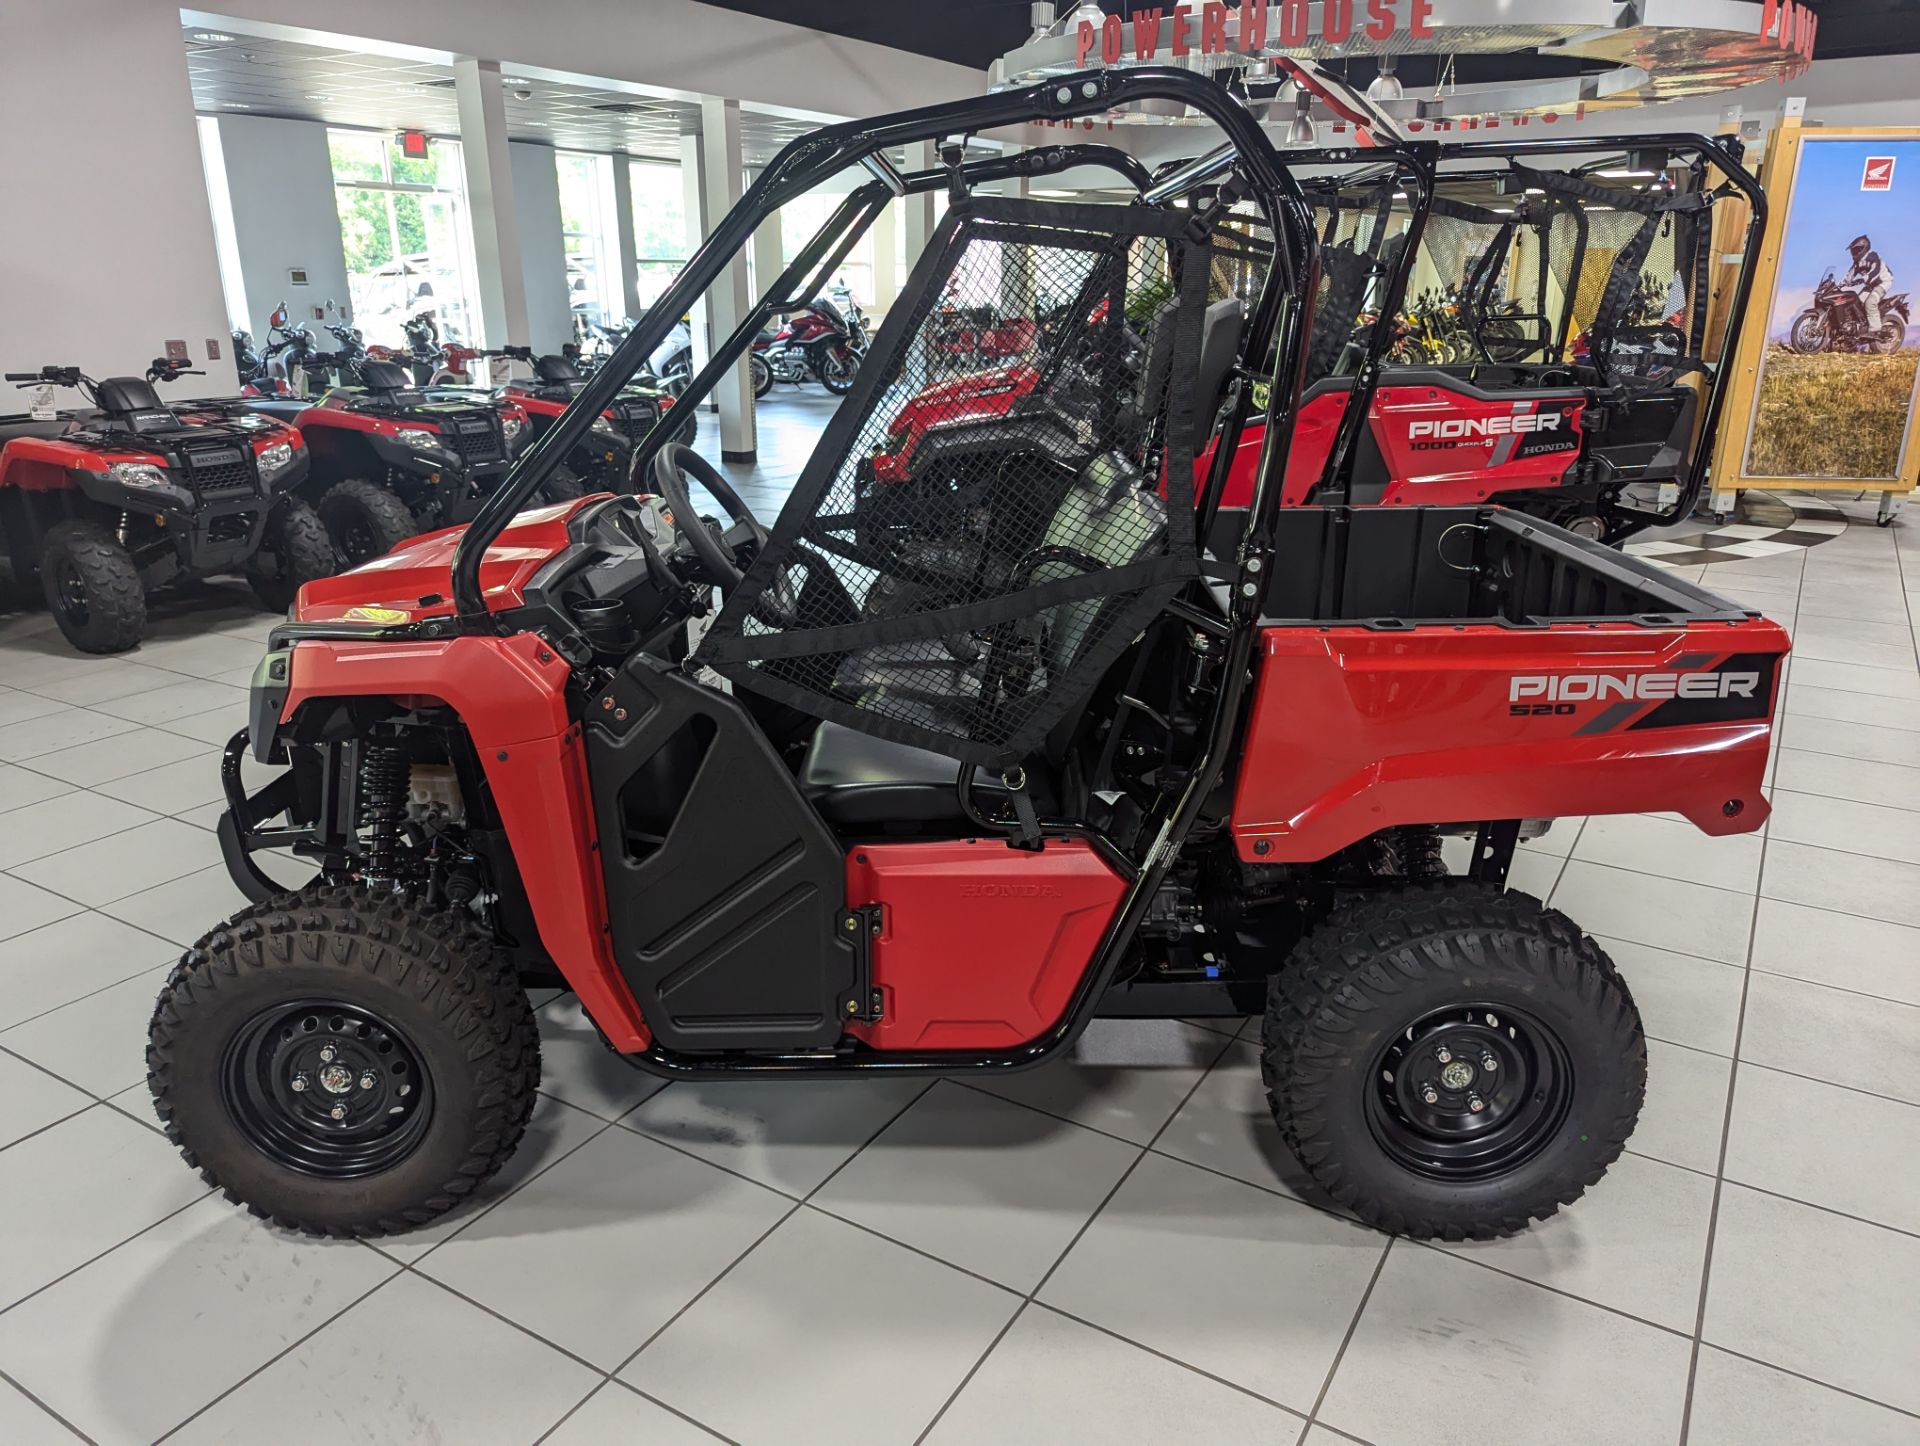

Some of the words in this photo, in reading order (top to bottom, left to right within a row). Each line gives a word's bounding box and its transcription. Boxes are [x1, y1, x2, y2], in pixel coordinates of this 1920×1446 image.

[1076, 0, 1434, 68] POWERHOUSE
[1408, 413, 1562, 440] PIONEER
[1409, 440, 1457, 451] 1000
[1524, 441, 1575, 455] HONDA
[196, 452, 238, 464] HONDA
[1509, 671, 1760, 702] PIONEER
[1509, 703, 1576, 716] 520
[960, 884, 1062, 898] HONDA
